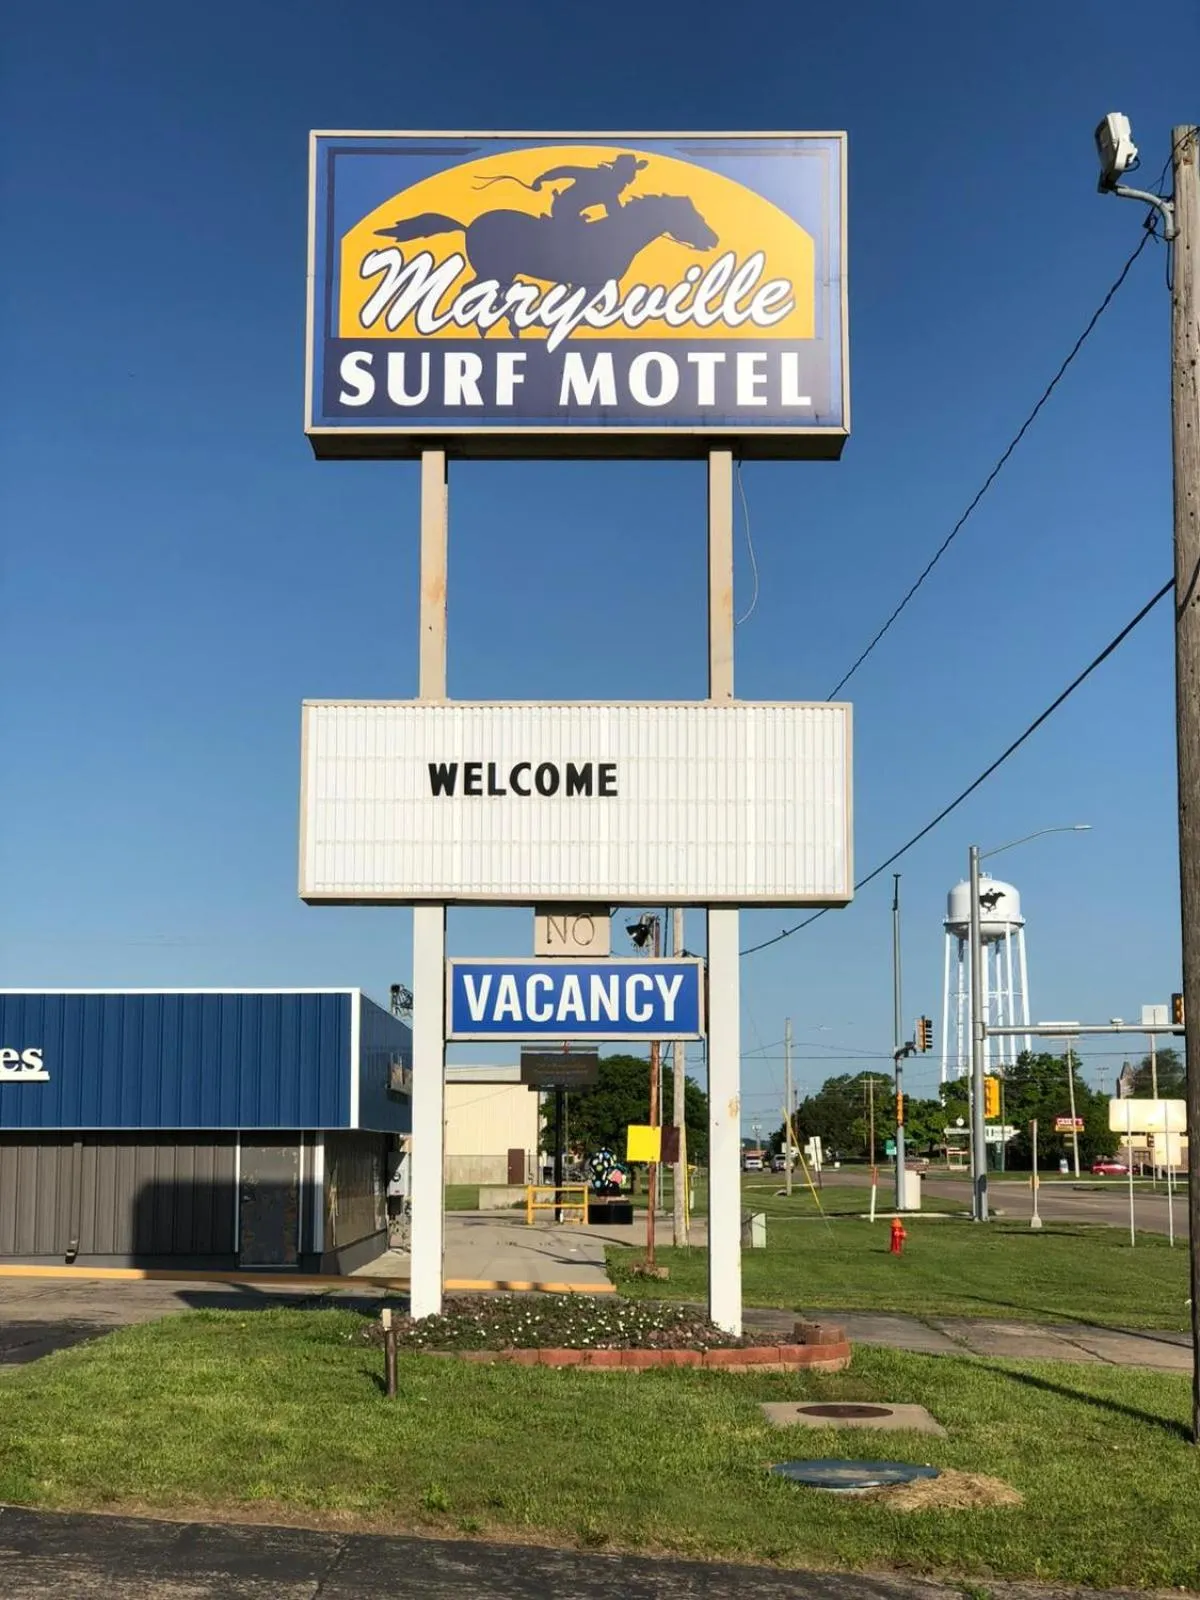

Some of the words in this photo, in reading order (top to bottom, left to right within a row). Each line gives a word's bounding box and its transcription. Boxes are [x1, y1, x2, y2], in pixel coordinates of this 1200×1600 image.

[359, 246, 796, 353] Marysville
[339, 350, 527, 407] SURF
[559, 351, 812, 407] MOTEL
[428, 762, 618, 797] WELCOME
[546, 912, 596, 946] NO
[463, 973, 684, 1022] VACANCY
